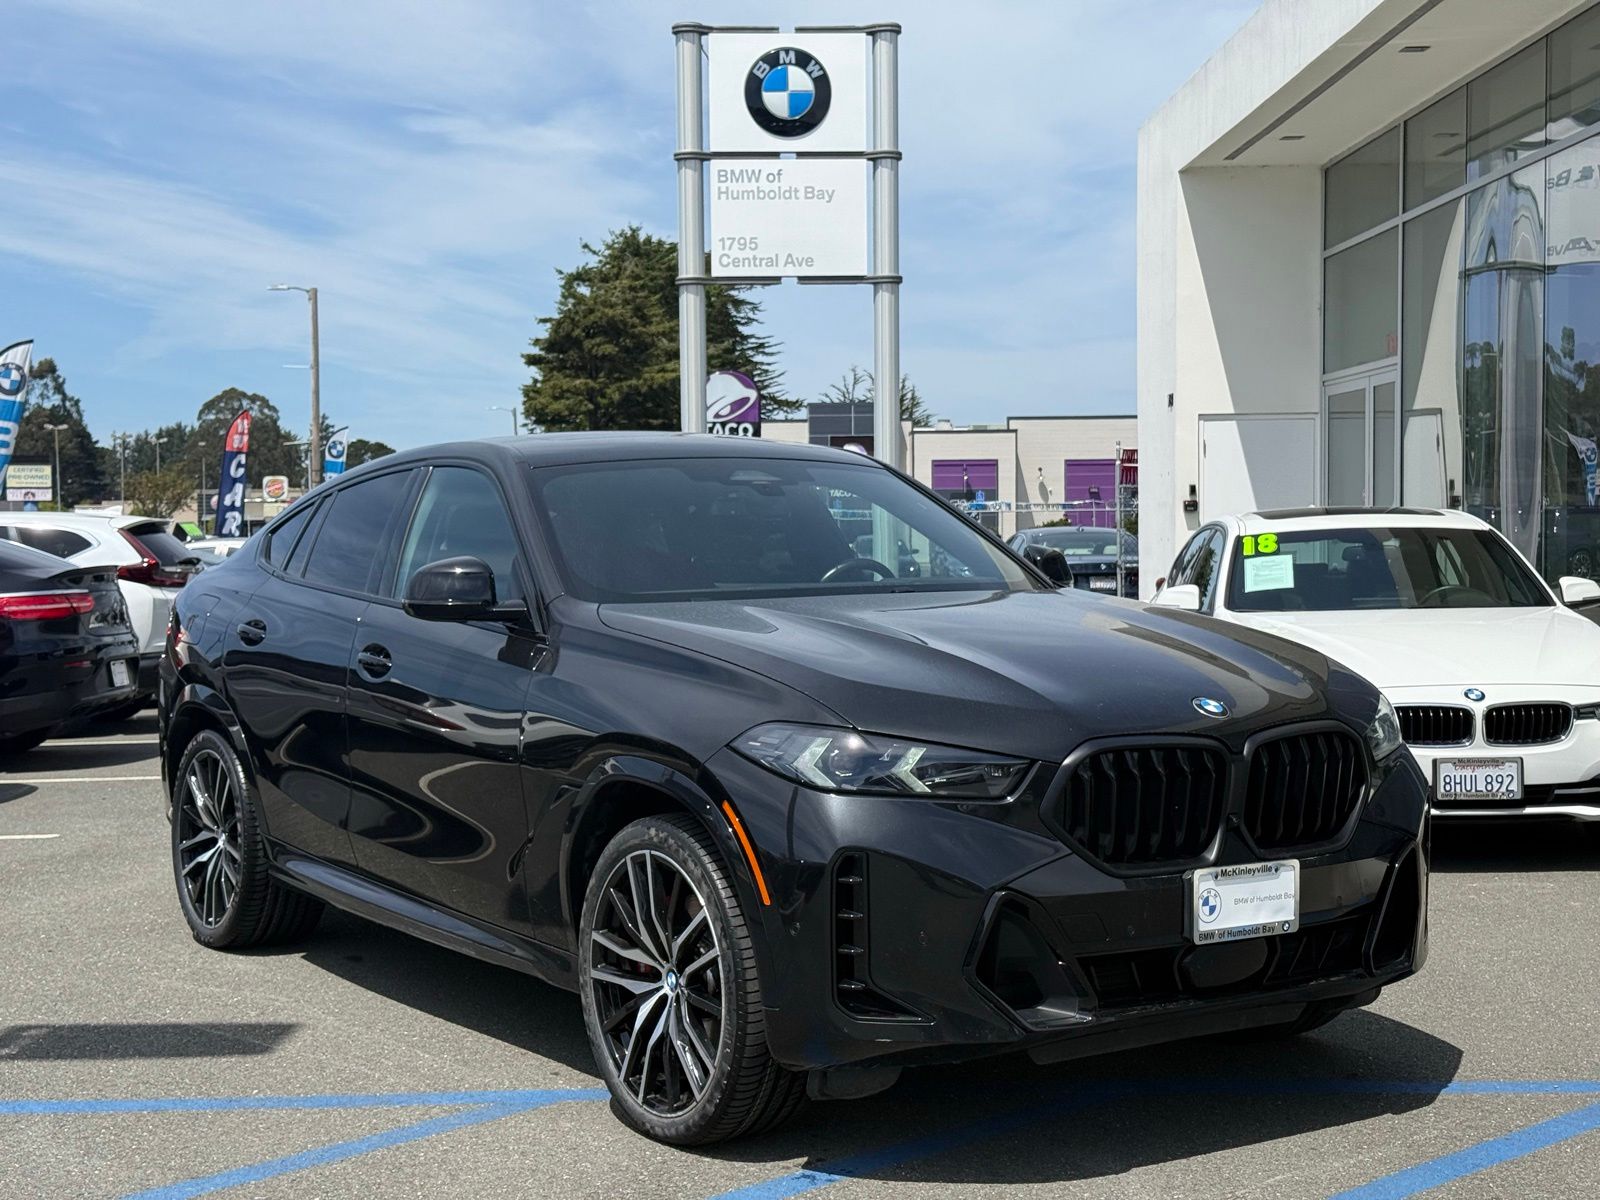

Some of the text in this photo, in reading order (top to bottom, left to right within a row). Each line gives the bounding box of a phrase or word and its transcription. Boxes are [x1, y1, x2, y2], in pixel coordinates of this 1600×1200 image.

[752, 50, 825, 79] BMW
[717, 168, 783, 184] BMW of
[717, 186, 836, 204] Humboldt Bay
[718, 236, 759, 252] 1795
[718, 253, 815, 268] Central Ave
[706, 422, 754, 437] TACO
[221, 453, 247, 538] CAR
[1242, 533, 1278, 556] 18
[1443, 774, 1515, 793] 8HUL892
[1220, 864, 1273, 879] McKinleyville
[1234, 897, 1250, 906] BMW
[1256, 893, 1283, 903] Humboldt
[1198, 925, 1276, 942] BMW of Humboldt Bay
